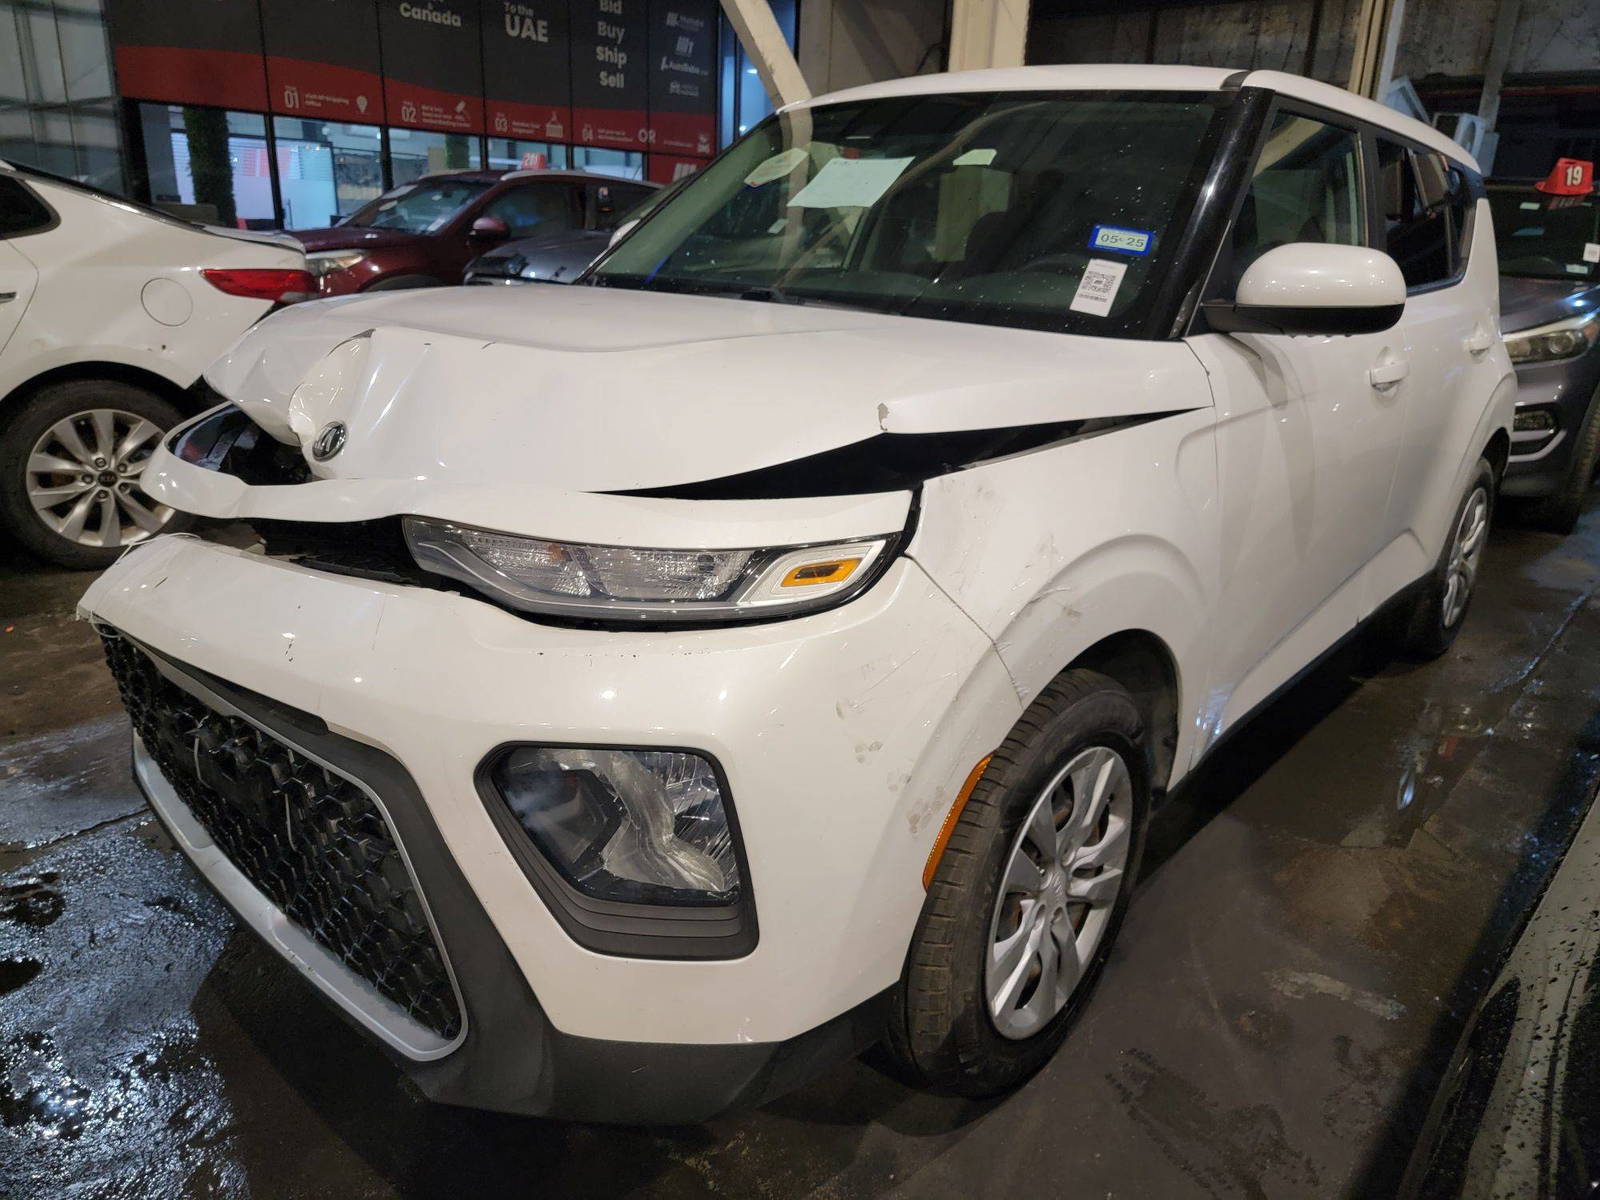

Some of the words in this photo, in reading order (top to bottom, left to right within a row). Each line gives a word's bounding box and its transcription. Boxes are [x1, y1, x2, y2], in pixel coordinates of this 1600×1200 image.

[400, 3, 462, 27] Canada
[600, 0, 622, 14] Bid
[504, 14, 549, 43] UAE
[598, 21, 625, 44] Buy
[596, 46, 627, 69] Ship
[599, 71, 625, 88] Sell
[284, 91, 299, 109] 01
[401, 105, 417, 123] 02
[638, 128, 656, 144] OR
[1566, 166, 1583, 185] 19
